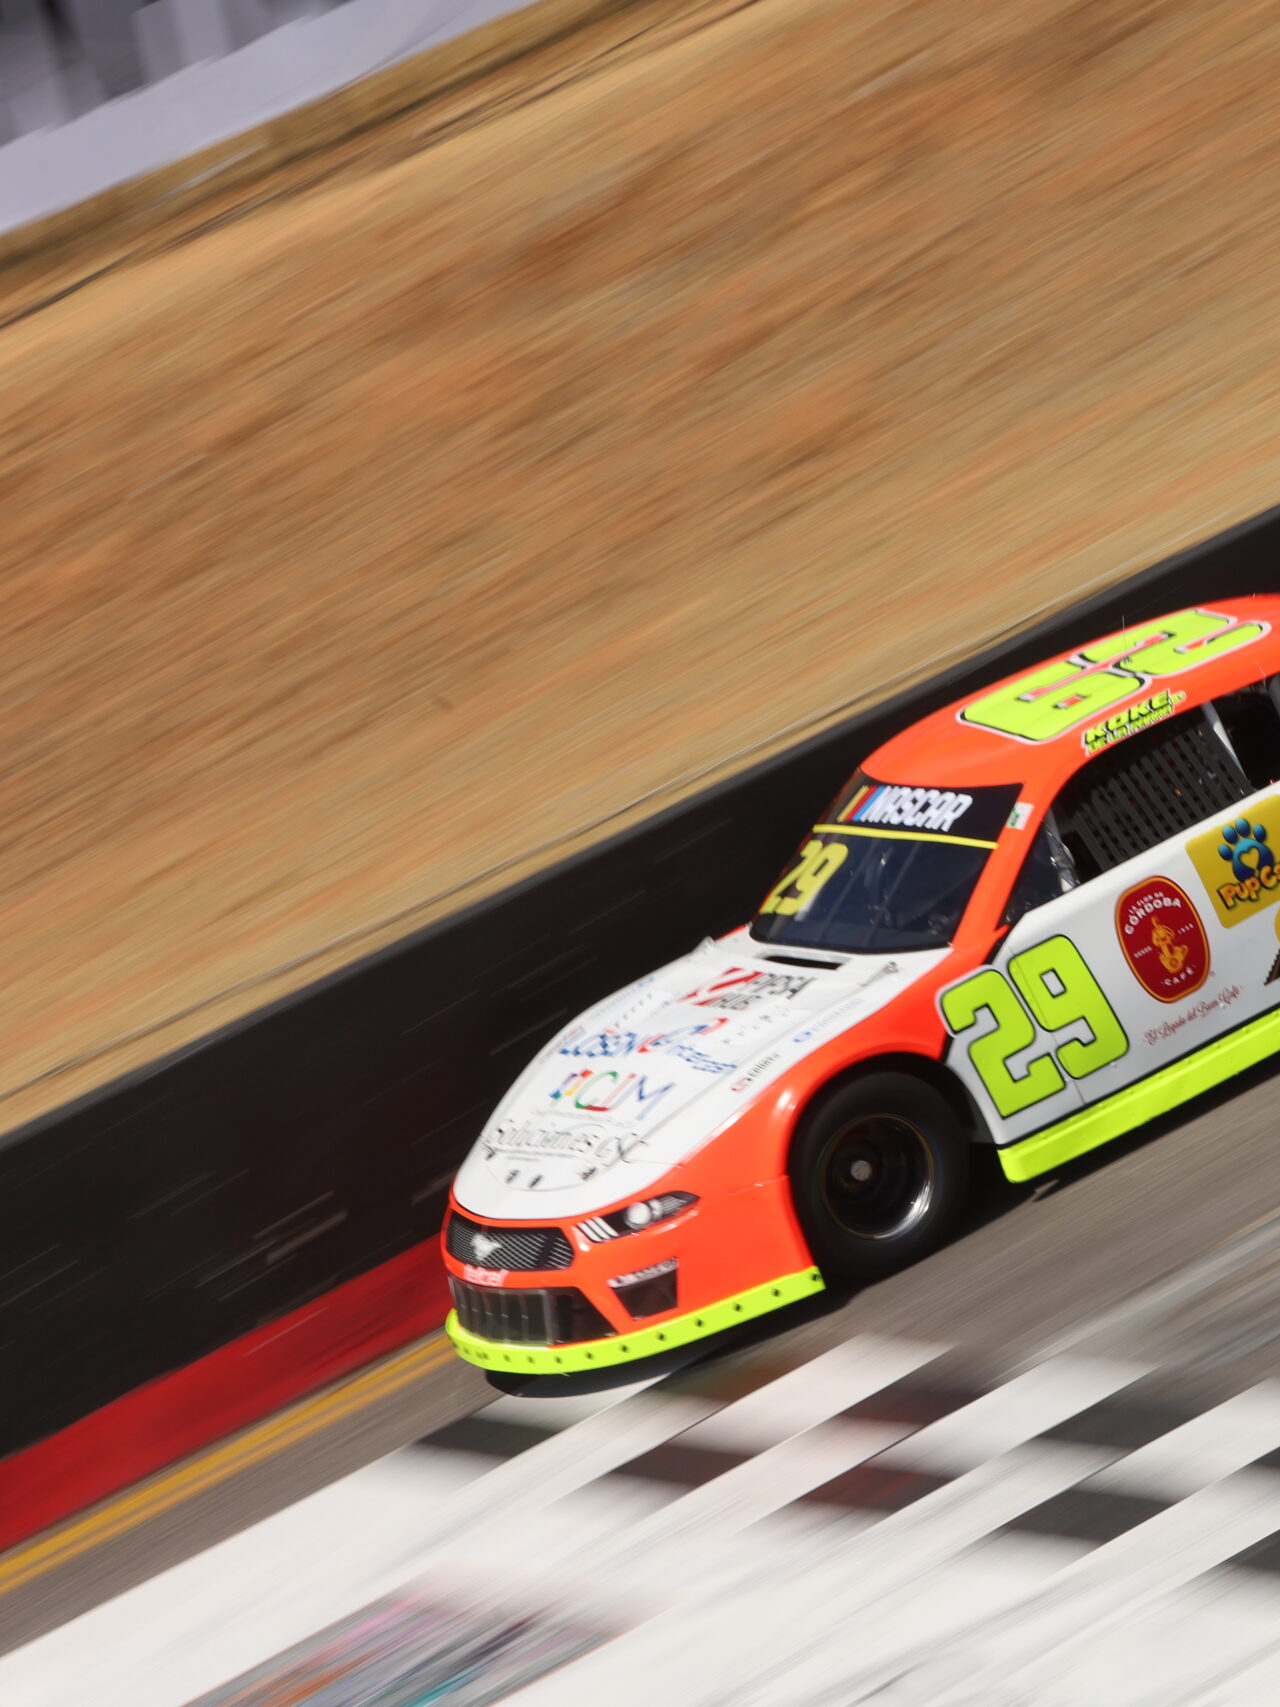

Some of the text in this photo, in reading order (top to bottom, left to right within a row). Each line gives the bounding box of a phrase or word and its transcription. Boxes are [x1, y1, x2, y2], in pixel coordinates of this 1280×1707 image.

[1085, 690, 1172, 746] KOKE
[860, 785, 973, 833] NASCAR
[758, 839, 849, 920] 29
[939, 934, 1130, 1119] 29
